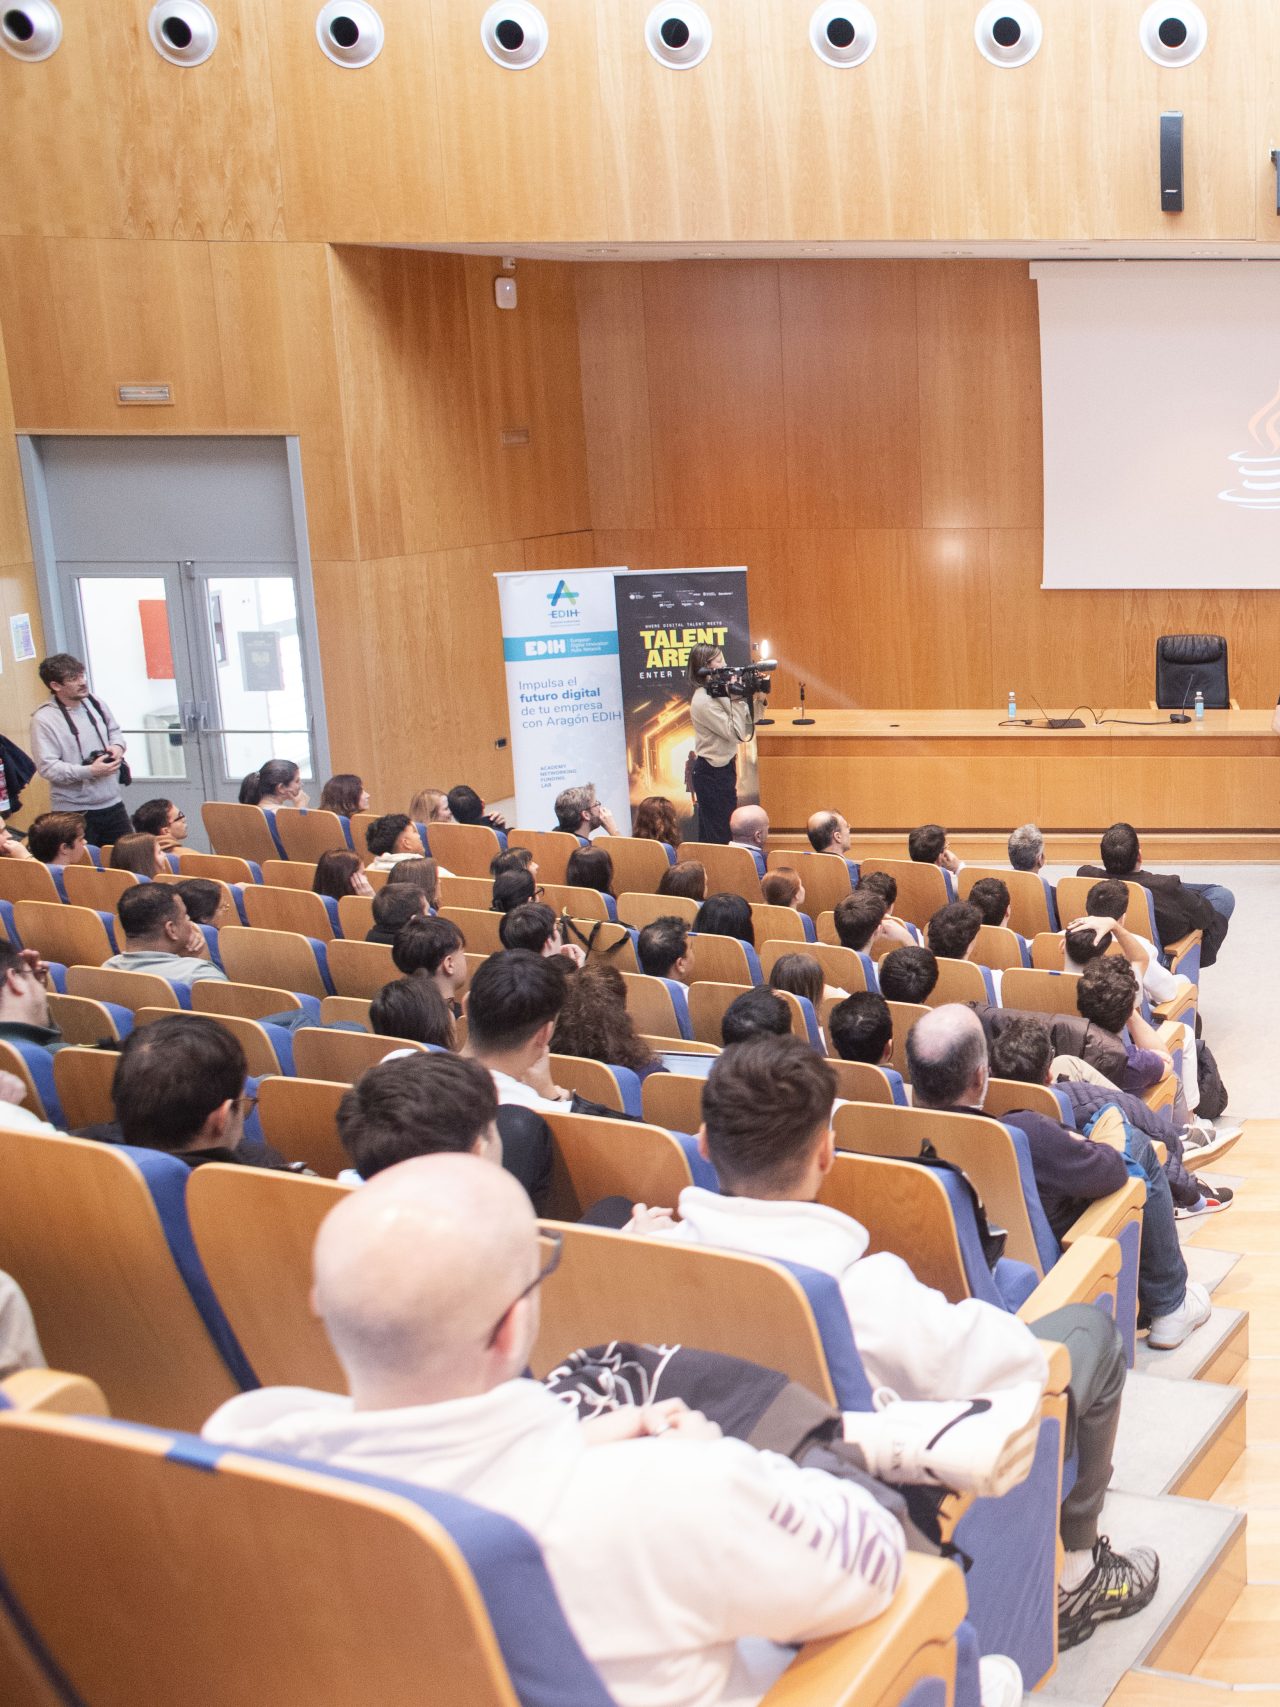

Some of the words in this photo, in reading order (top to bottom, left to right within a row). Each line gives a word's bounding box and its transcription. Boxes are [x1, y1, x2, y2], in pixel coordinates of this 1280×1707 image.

[551, 609, 578, 618] EDIH
[640, 627, 728, 649] TALENT
[525, 639, 566, 656] EDIH
[646, 648, 692, 669] ARE
[639, 670, 673, 680] ENTER
[519, 679, 564, 691] Impulsa
[567, 676, 577, 686] el
[520, 692, 558, 703] futuro
[562, 687, 600, 701] digital
[521, 706, 536, 716] de
[539, 705, 550, 714] tu
[554, 702, 603, 713] empresa
[522, 719, 543, 728] con
[546, 714, 589, 727] Aragón
[592, 711, 622, 722] EDIH
